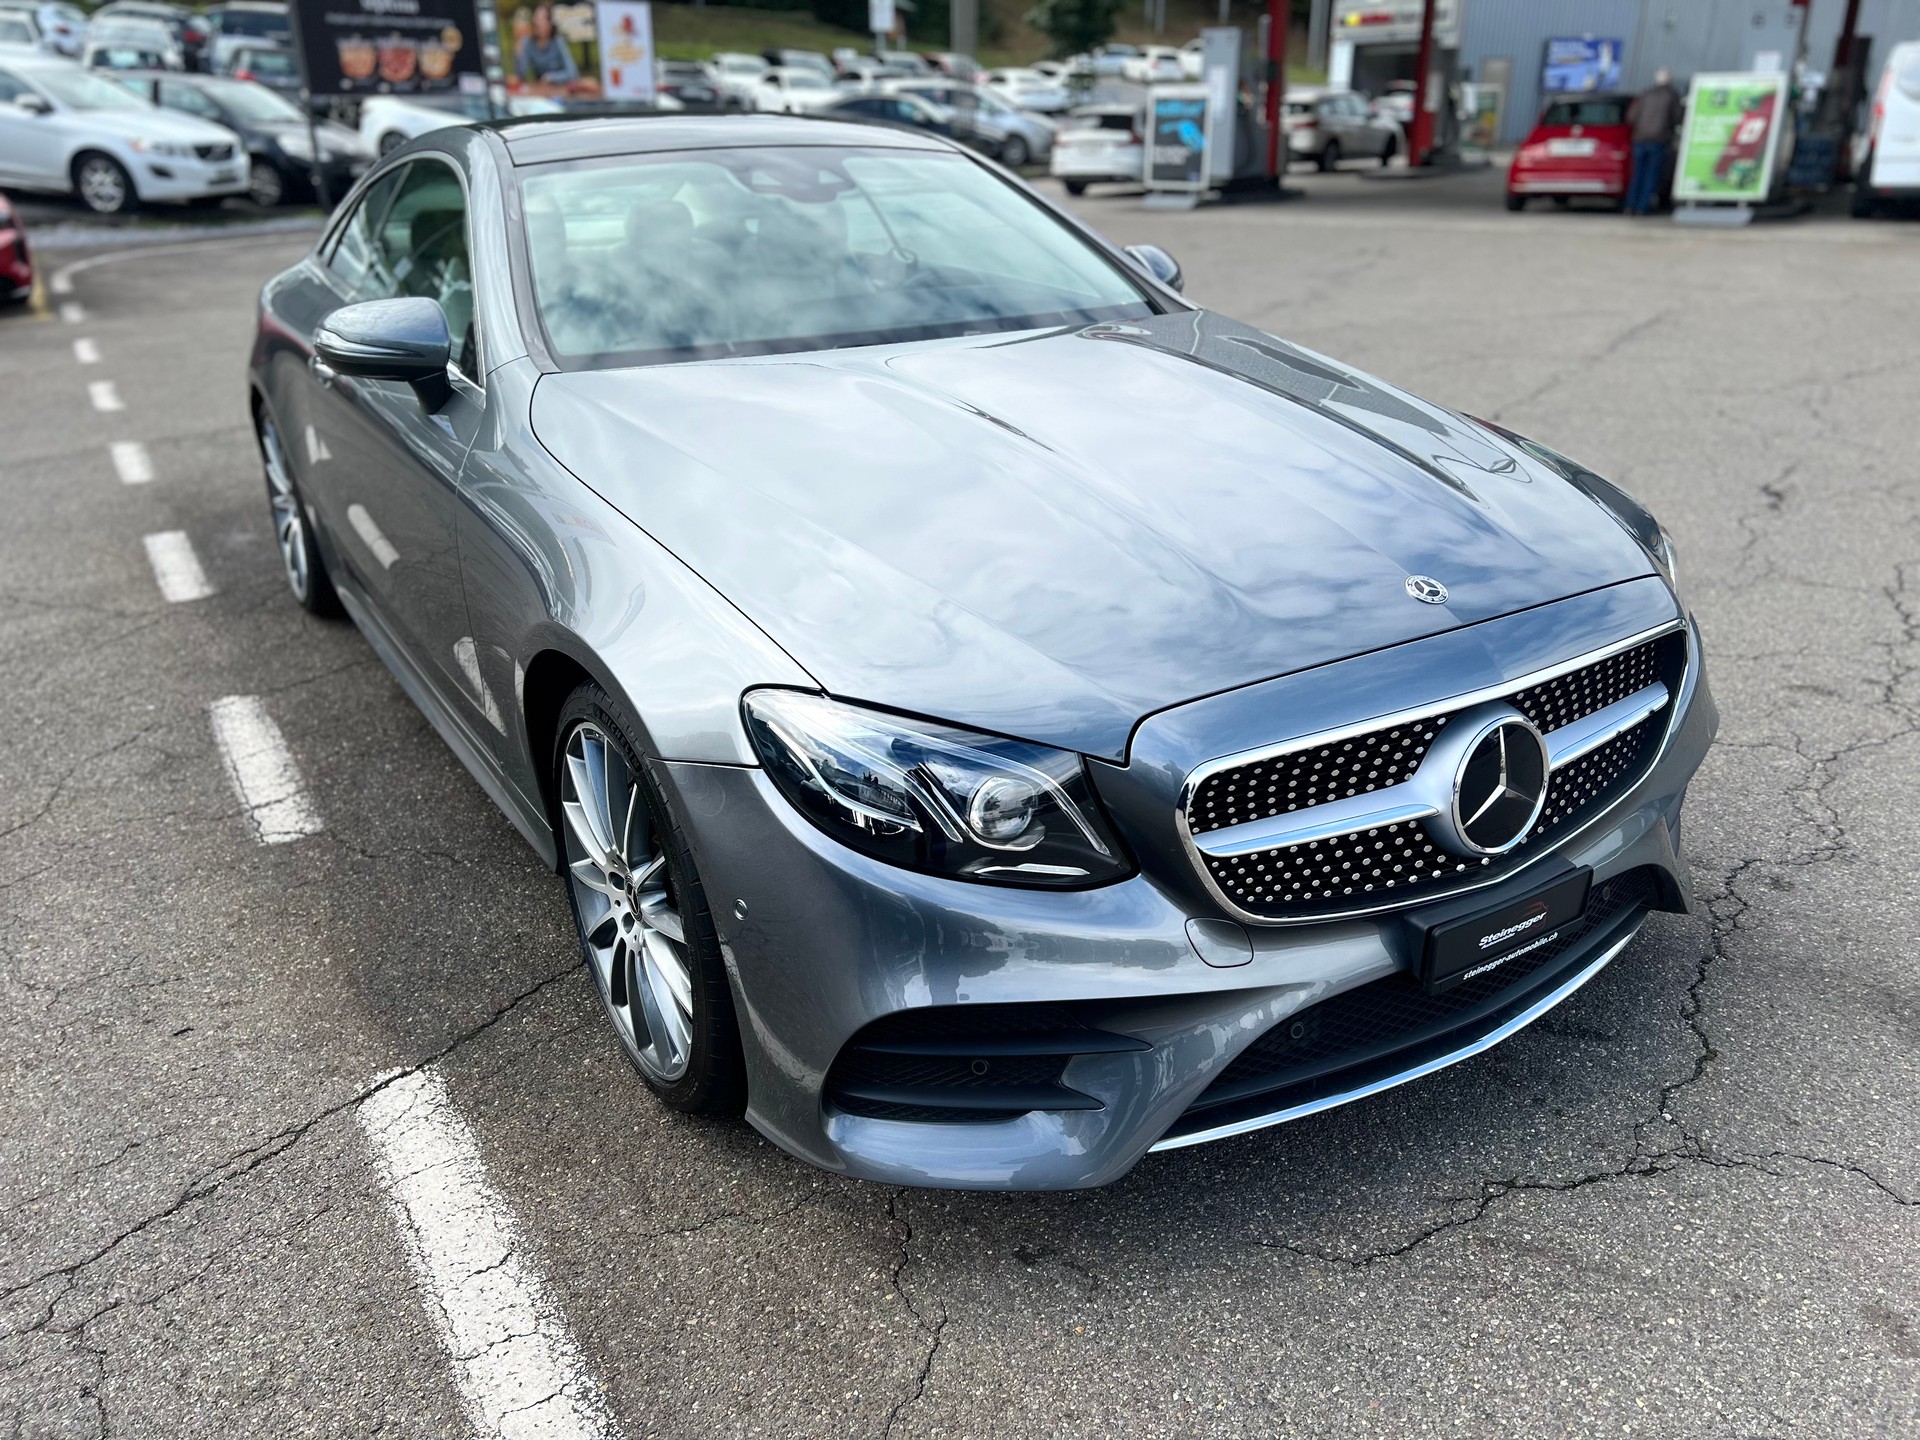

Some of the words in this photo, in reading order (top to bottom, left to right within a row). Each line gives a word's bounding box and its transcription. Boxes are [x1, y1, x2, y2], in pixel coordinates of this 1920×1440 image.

[600, 711, 641, 773] MICHELIN
[1478, 911, 1547, 947] Steinegger
[1462, 932, 1559, 981] steinegger-automobile.ch
